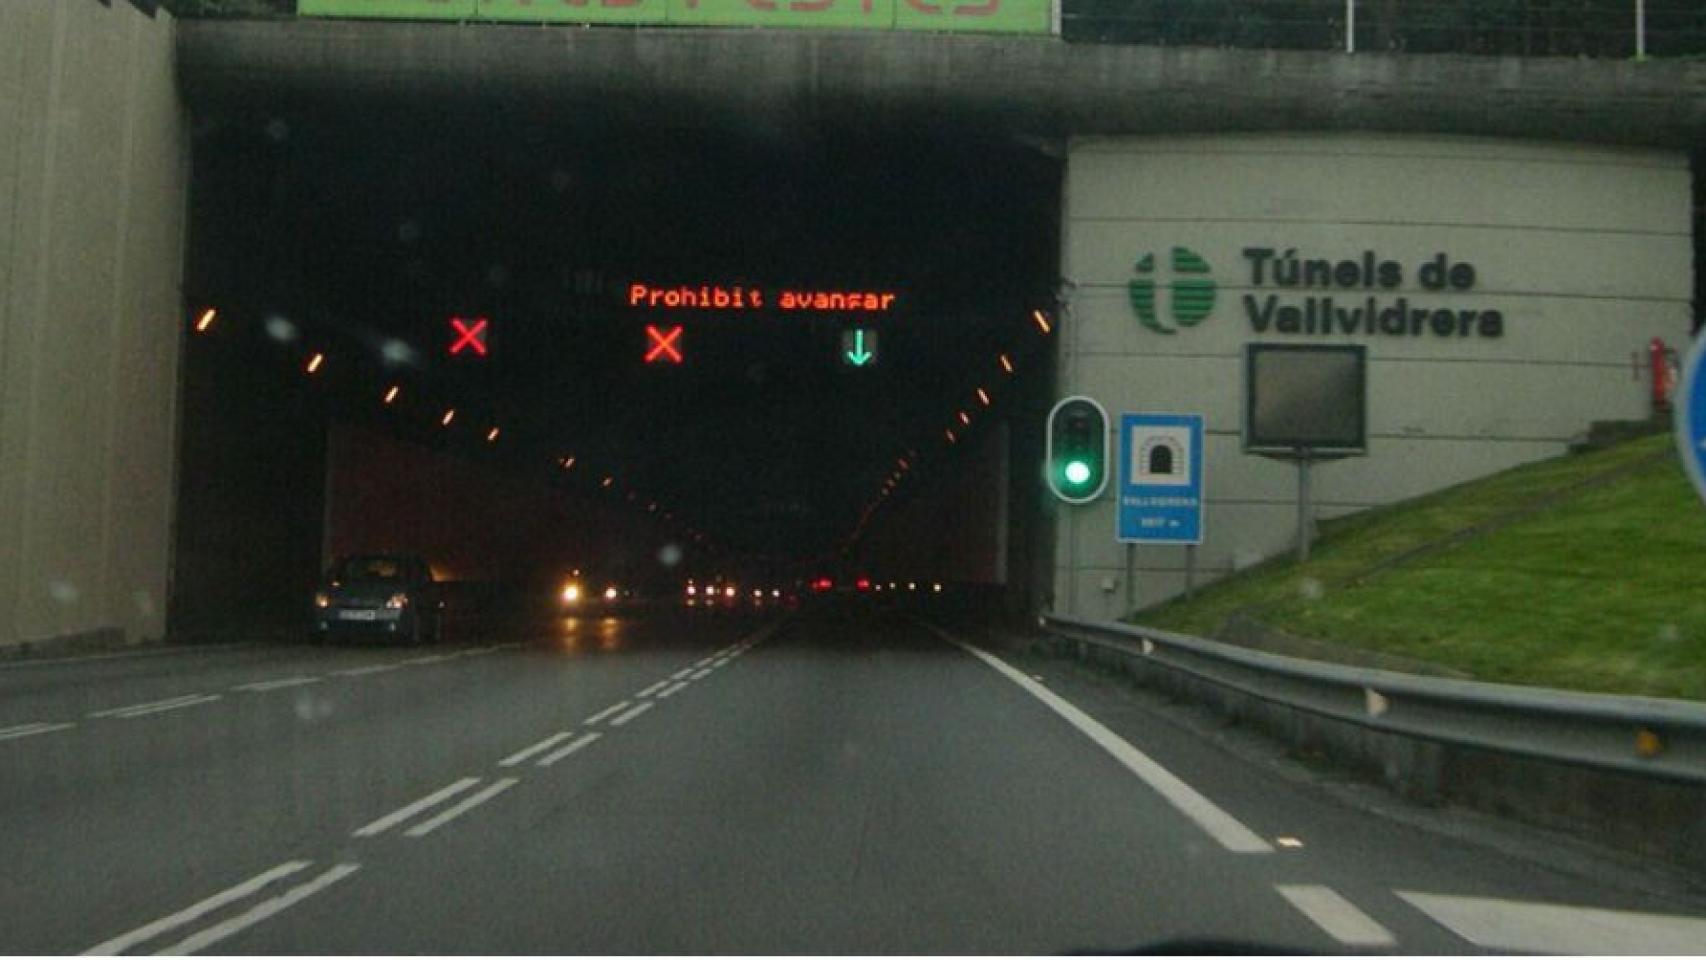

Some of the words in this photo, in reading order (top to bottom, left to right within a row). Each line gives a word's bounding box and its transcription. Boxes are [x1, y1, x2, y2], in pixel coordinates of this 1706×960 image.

[1243, 247, 1401, 288] Túnels
[1419, 252, 1476, 289] de
[630, 284, 763, 307] Prohibit
[1243, 294, 1505, 338] Vallvidrera
